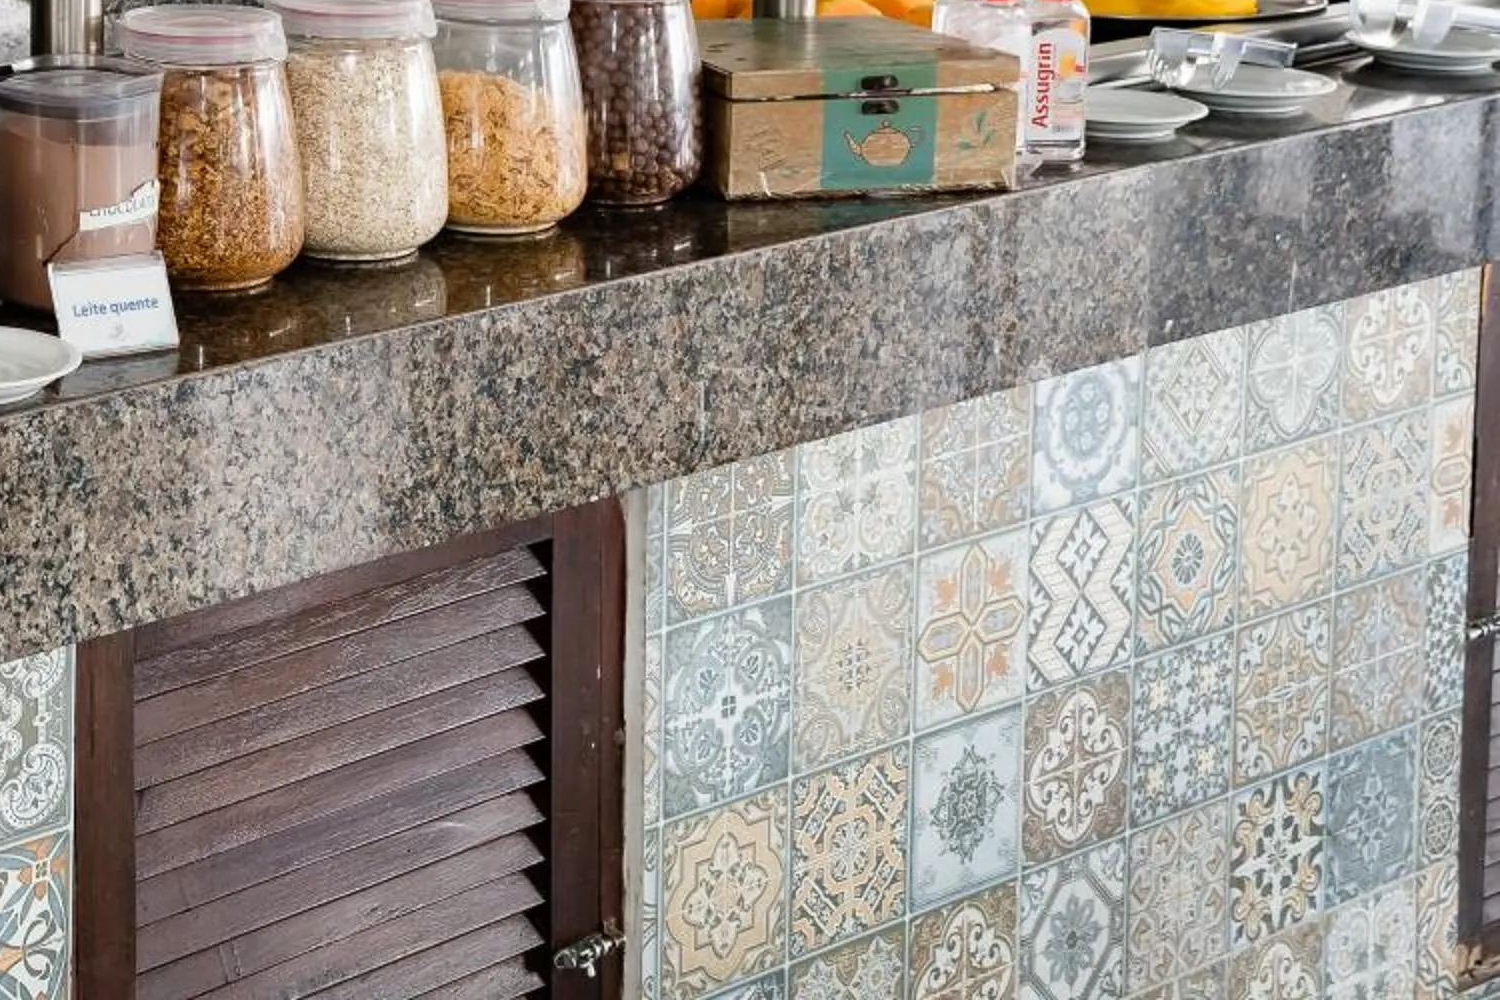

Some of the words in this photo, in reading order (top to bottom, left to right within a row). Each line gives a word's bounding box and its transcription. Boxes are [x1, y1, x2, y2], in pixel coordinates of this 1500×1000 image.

[1031, 42, 1056, 129] Assugrin
[72, 303, 108, 318] Leite
[109, 297, 160, 316] quente
